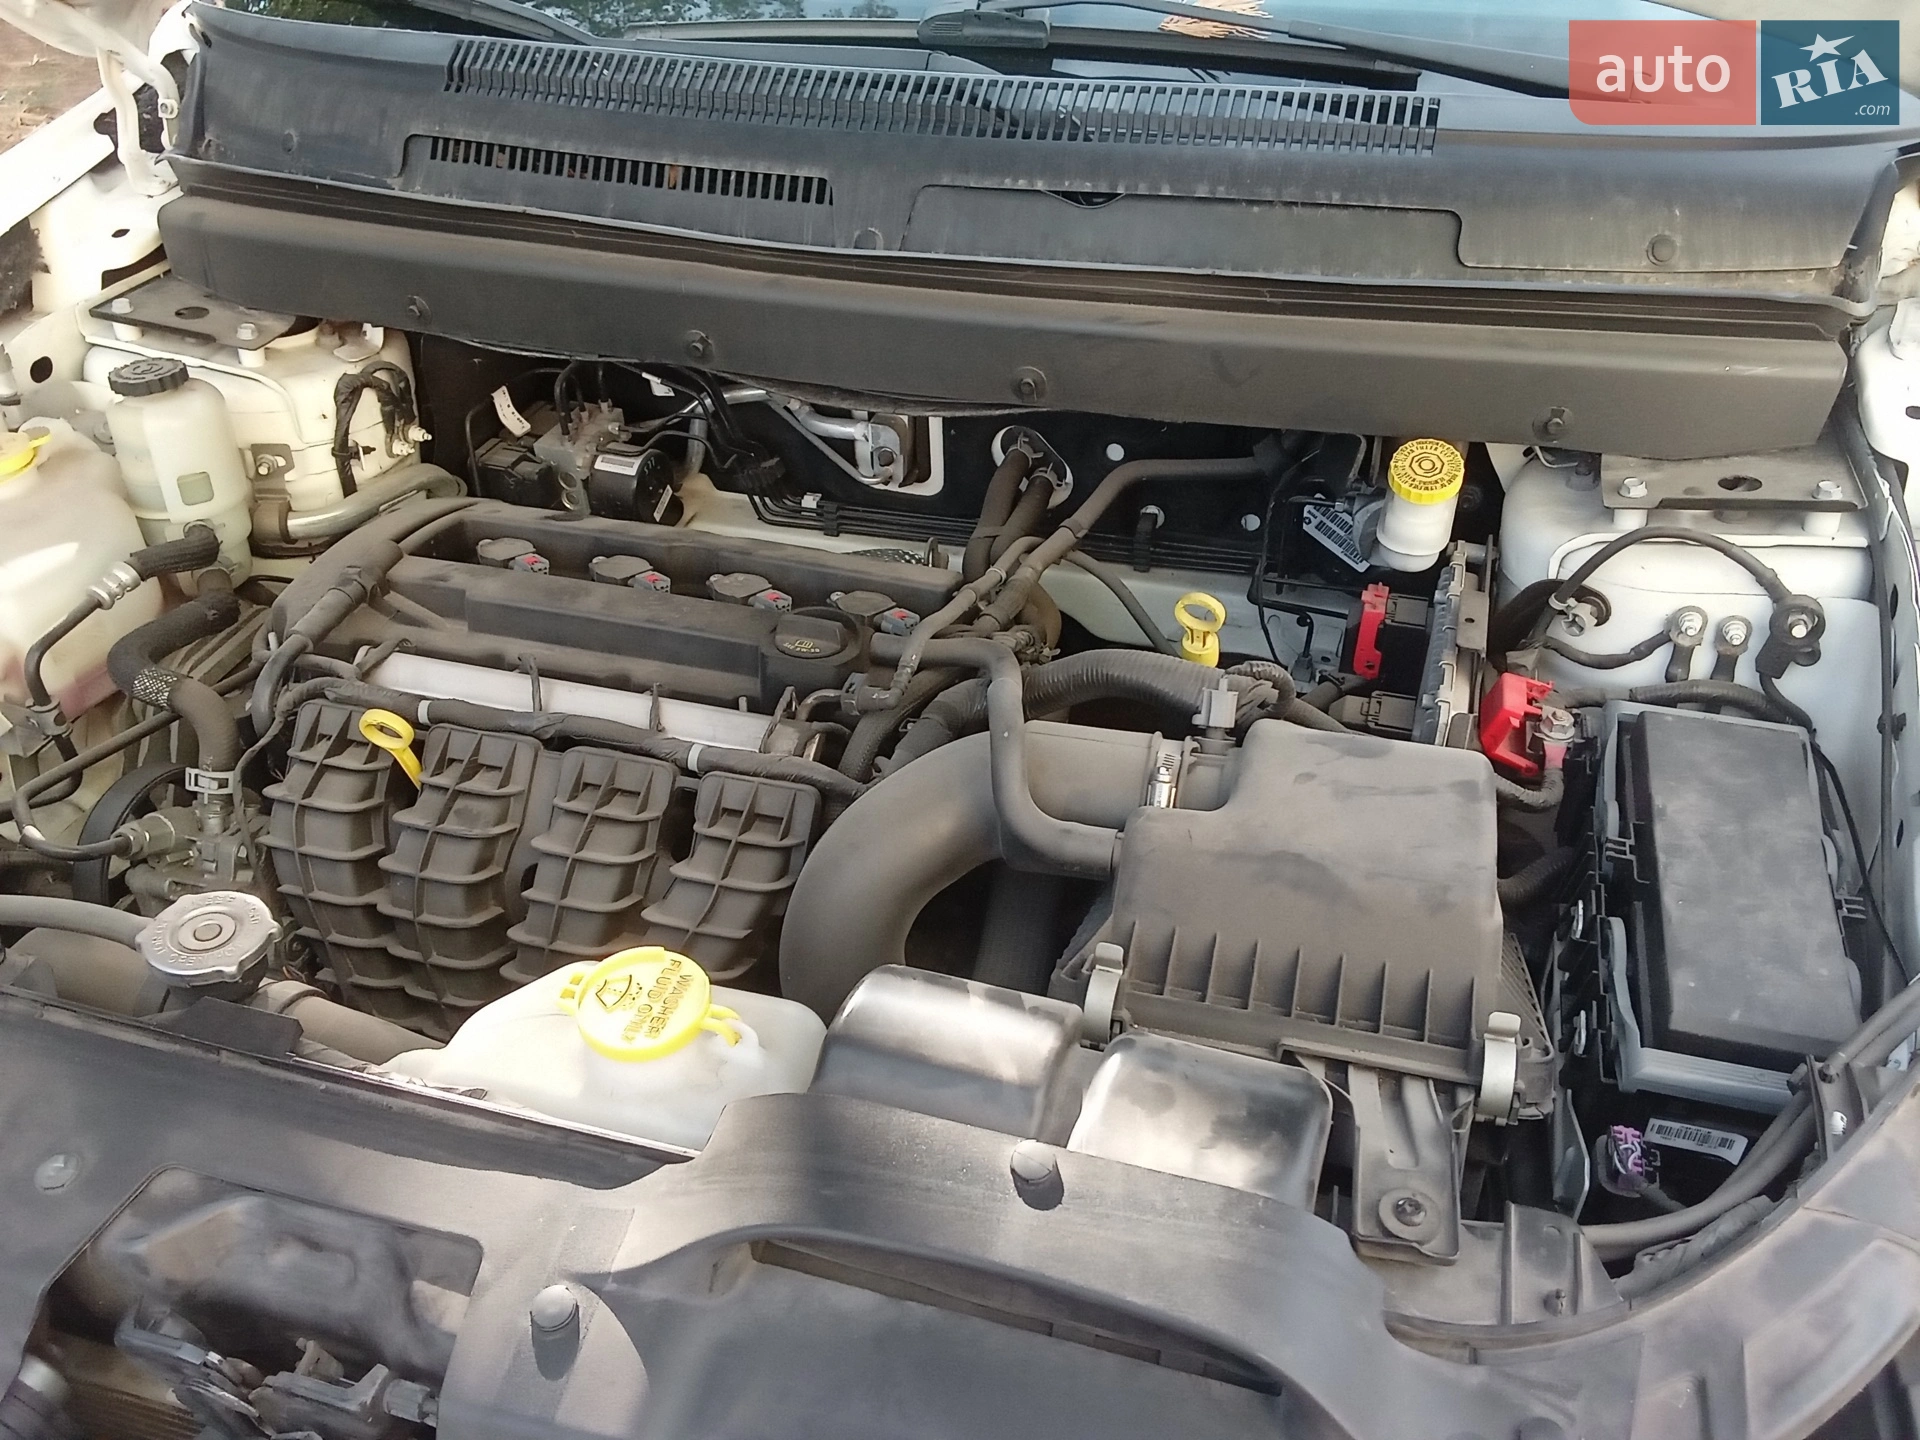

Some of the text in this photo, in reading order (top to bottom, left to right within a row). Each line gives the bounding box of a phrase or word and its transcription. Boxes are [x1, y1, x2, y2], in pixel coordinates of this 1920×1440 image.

[621, 957, 682, 1044] FLUID ONLY
[644, 973, 694, 1039] WASHER
